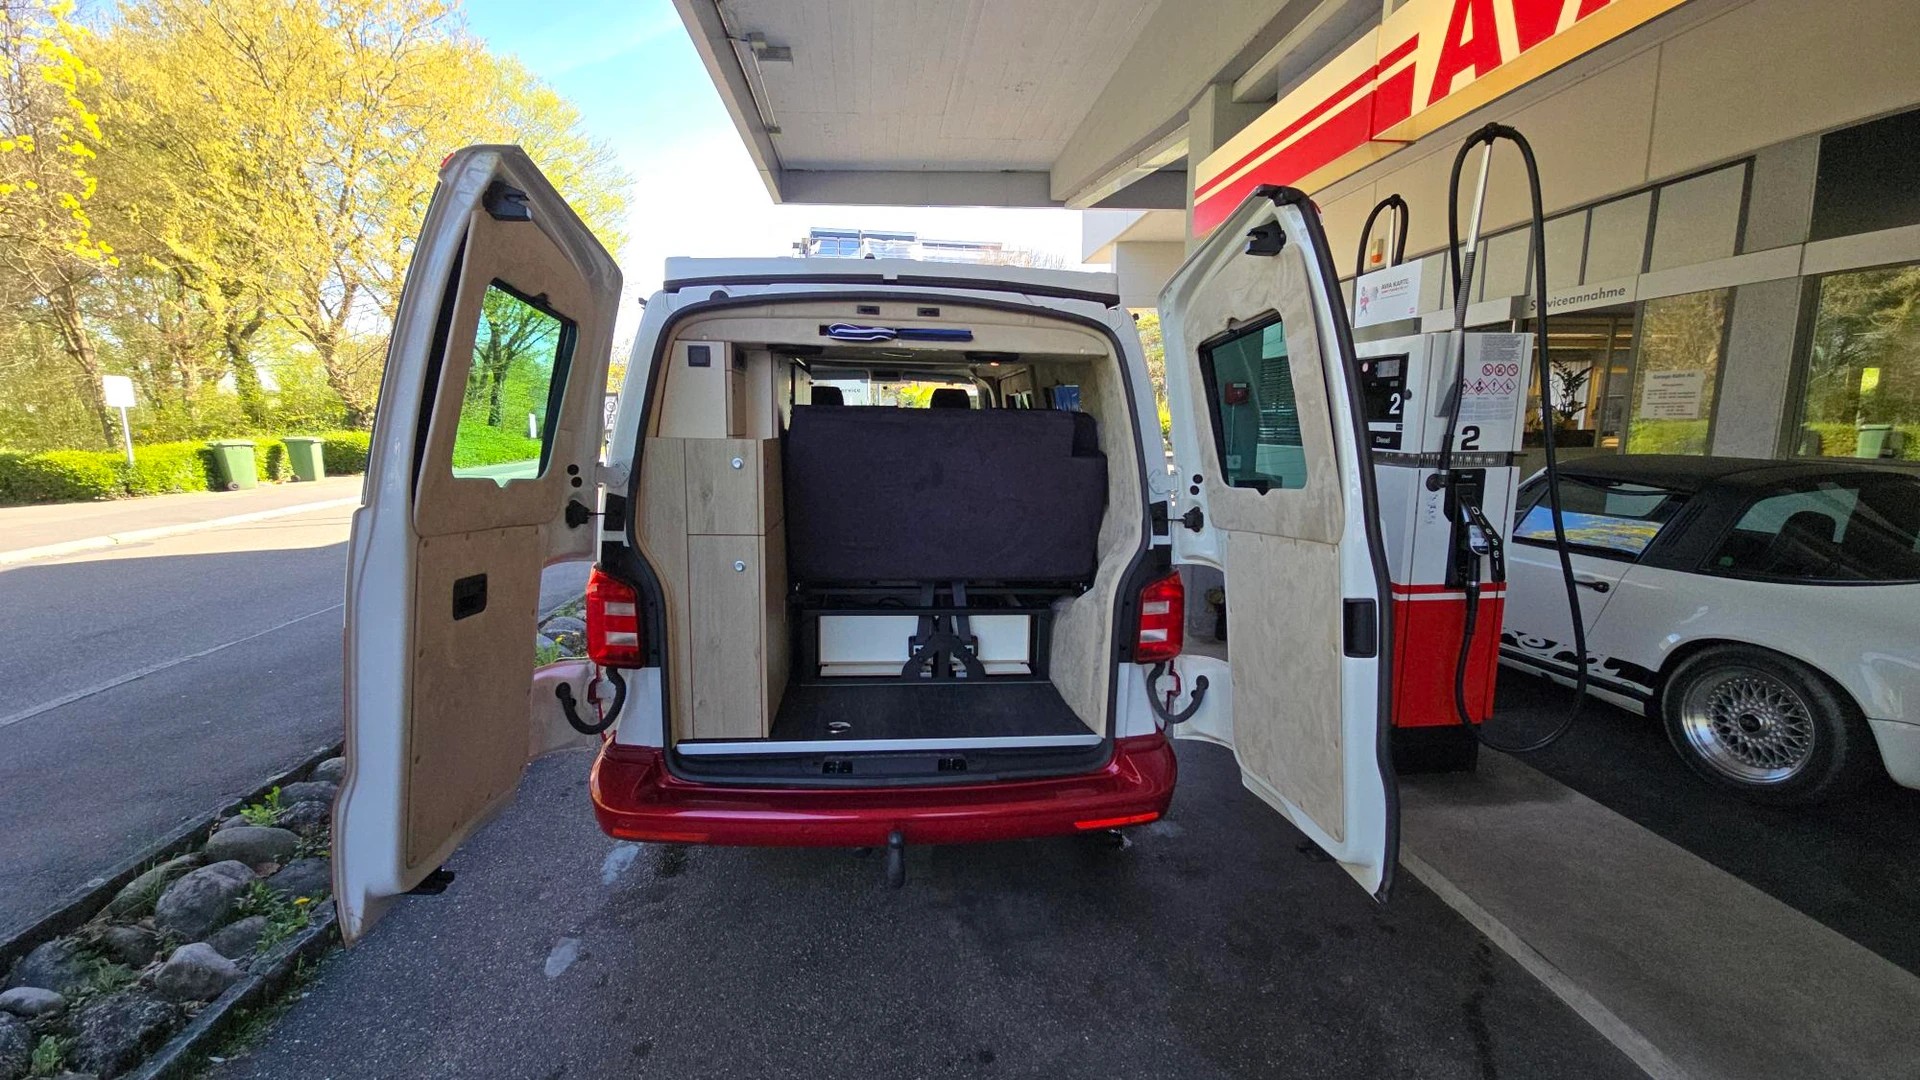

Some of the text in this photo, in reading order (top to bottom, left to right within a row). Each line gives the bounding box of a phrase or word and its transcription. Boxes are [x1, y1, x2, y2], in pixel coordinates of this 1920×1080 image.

[1530, 287, 1626, 311] Sviceannahme
[1389, 393, 1401, 414] 2
[1375, 436, 1391, 444] Diesel
[1460, 425, 1480, 451] 2
[1471, 506, 1500, 571] Diesel
